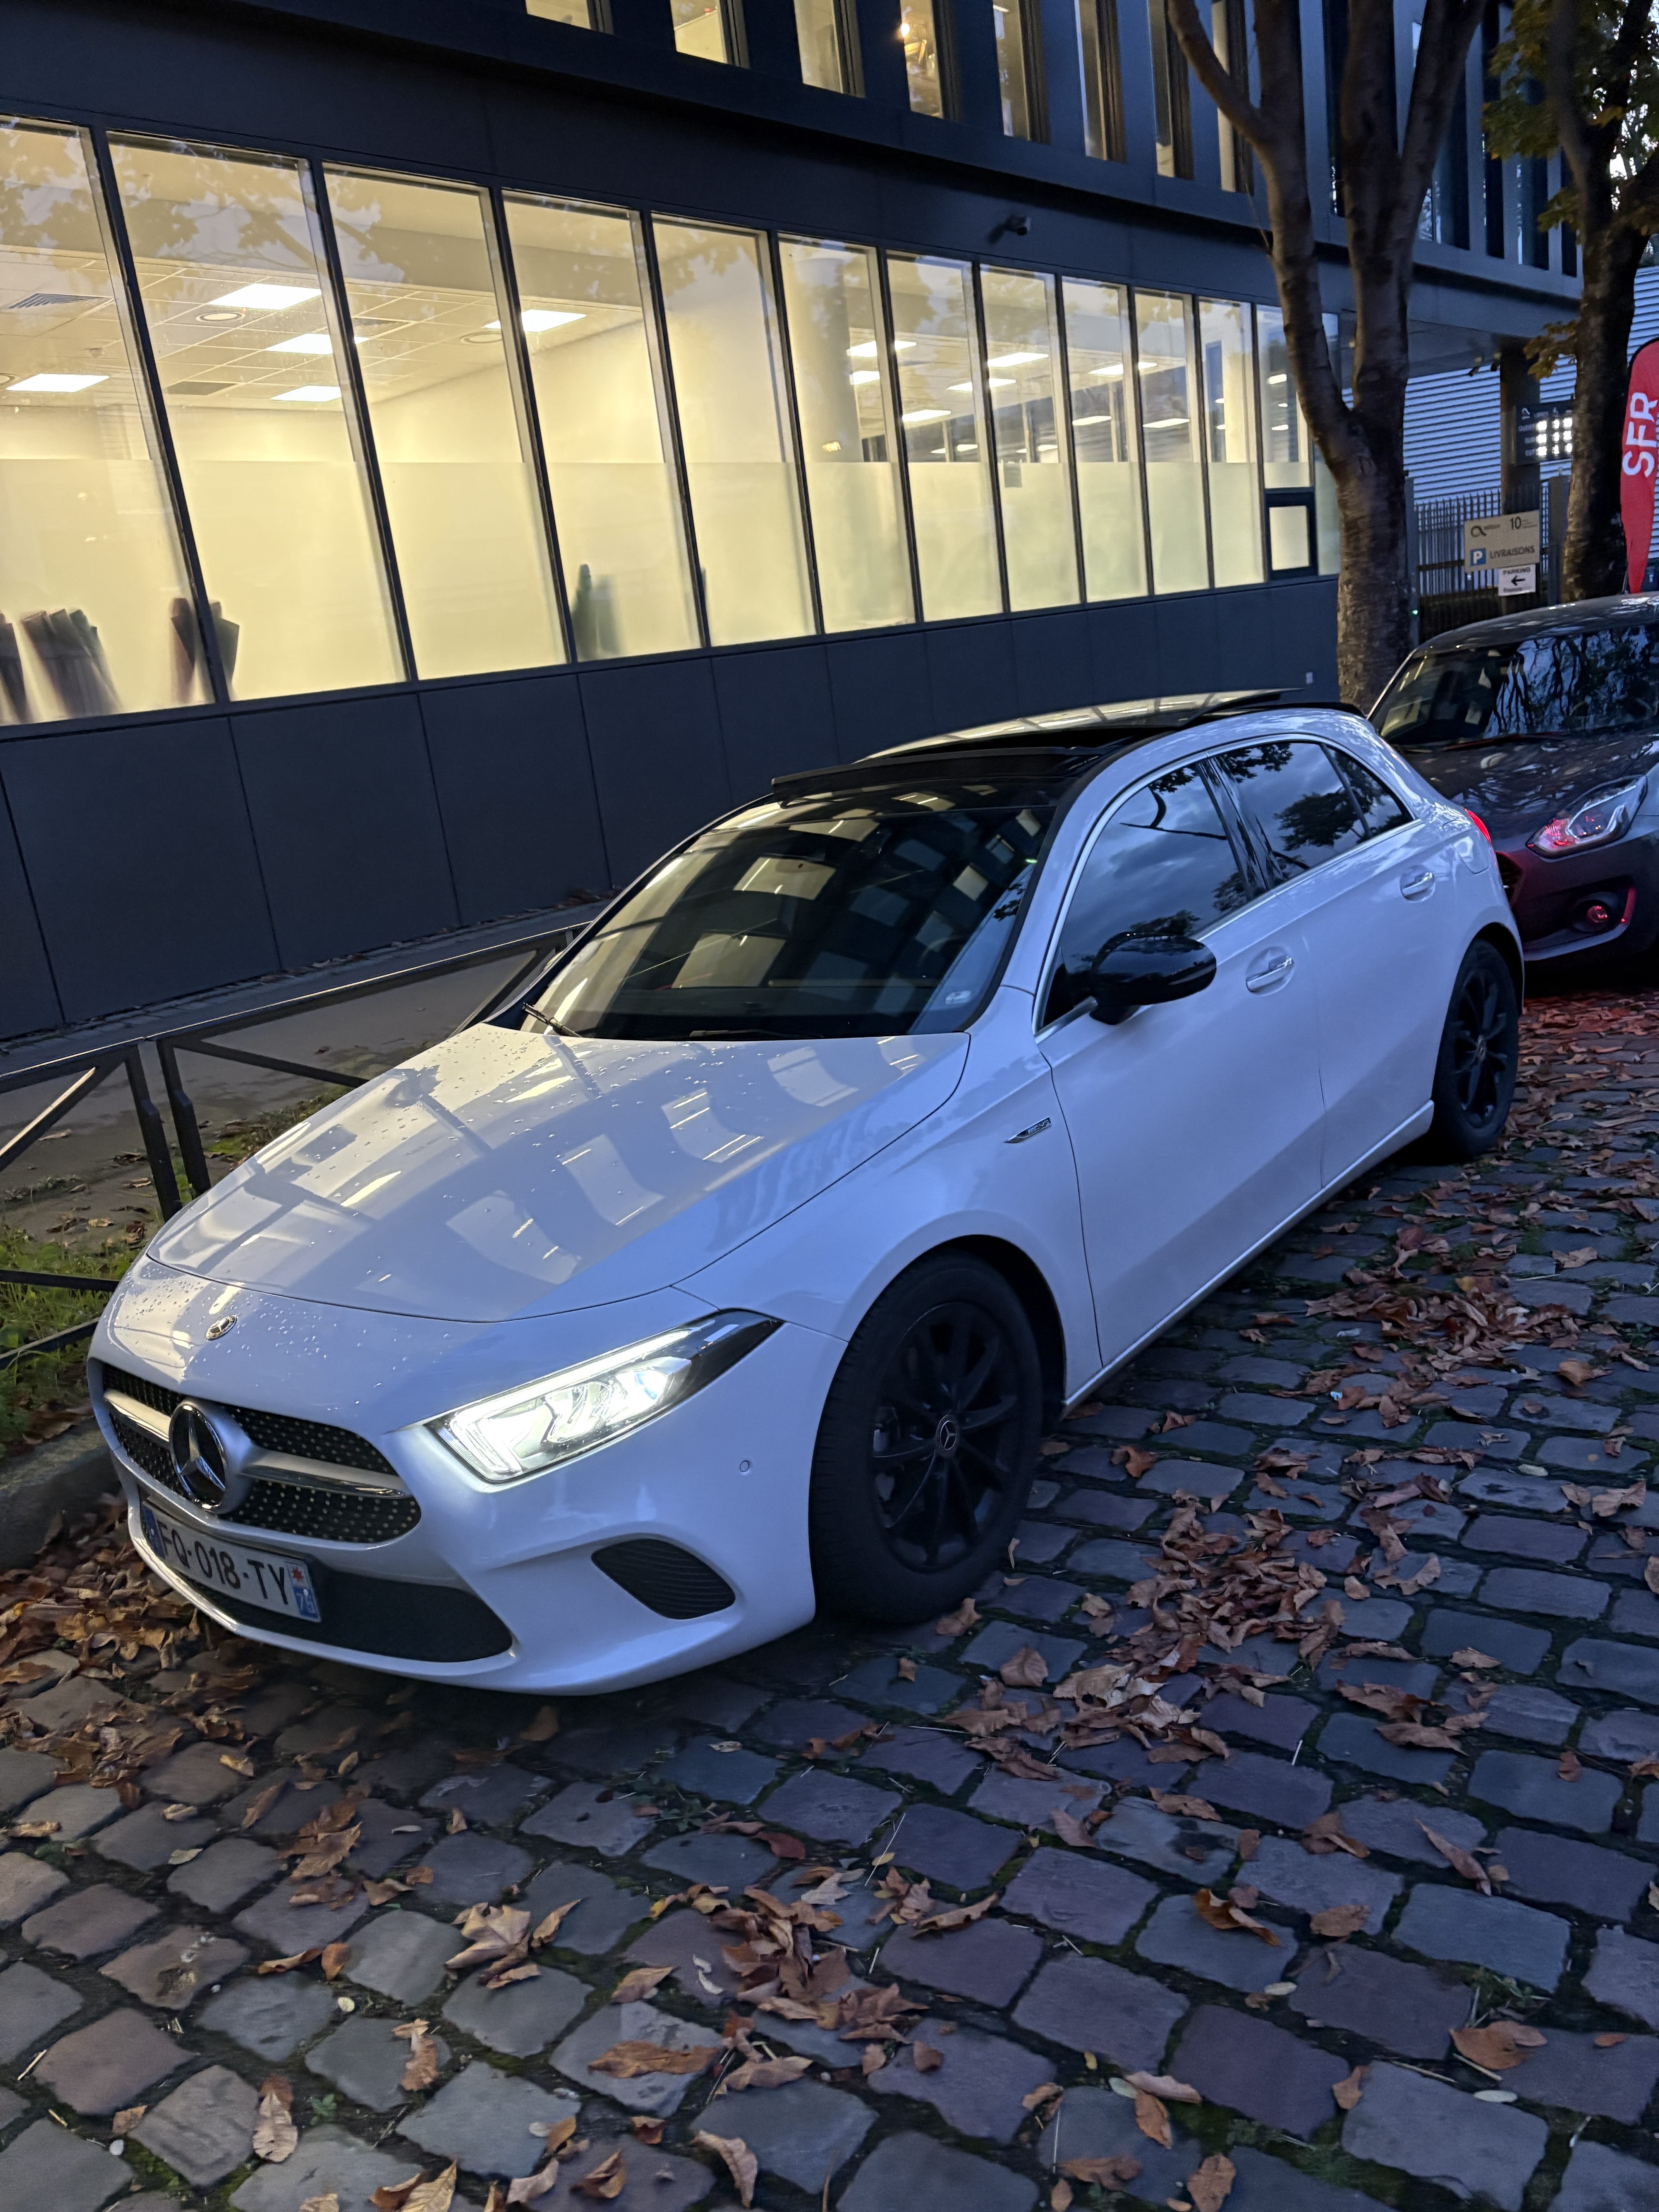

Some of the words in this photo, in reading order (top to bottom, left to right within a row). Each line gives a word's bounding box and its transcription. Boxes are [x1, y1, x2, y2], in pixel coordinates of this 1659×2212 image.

[1623, 392, 1658, 477] SFR
[1510, 516, 1521, 530] 10
[1473, 551, 1483, 564] P
[1490, 545, 1535, 559] LIVRAISONS
[156, 1519, 288, 1605] FQ-018-TY
